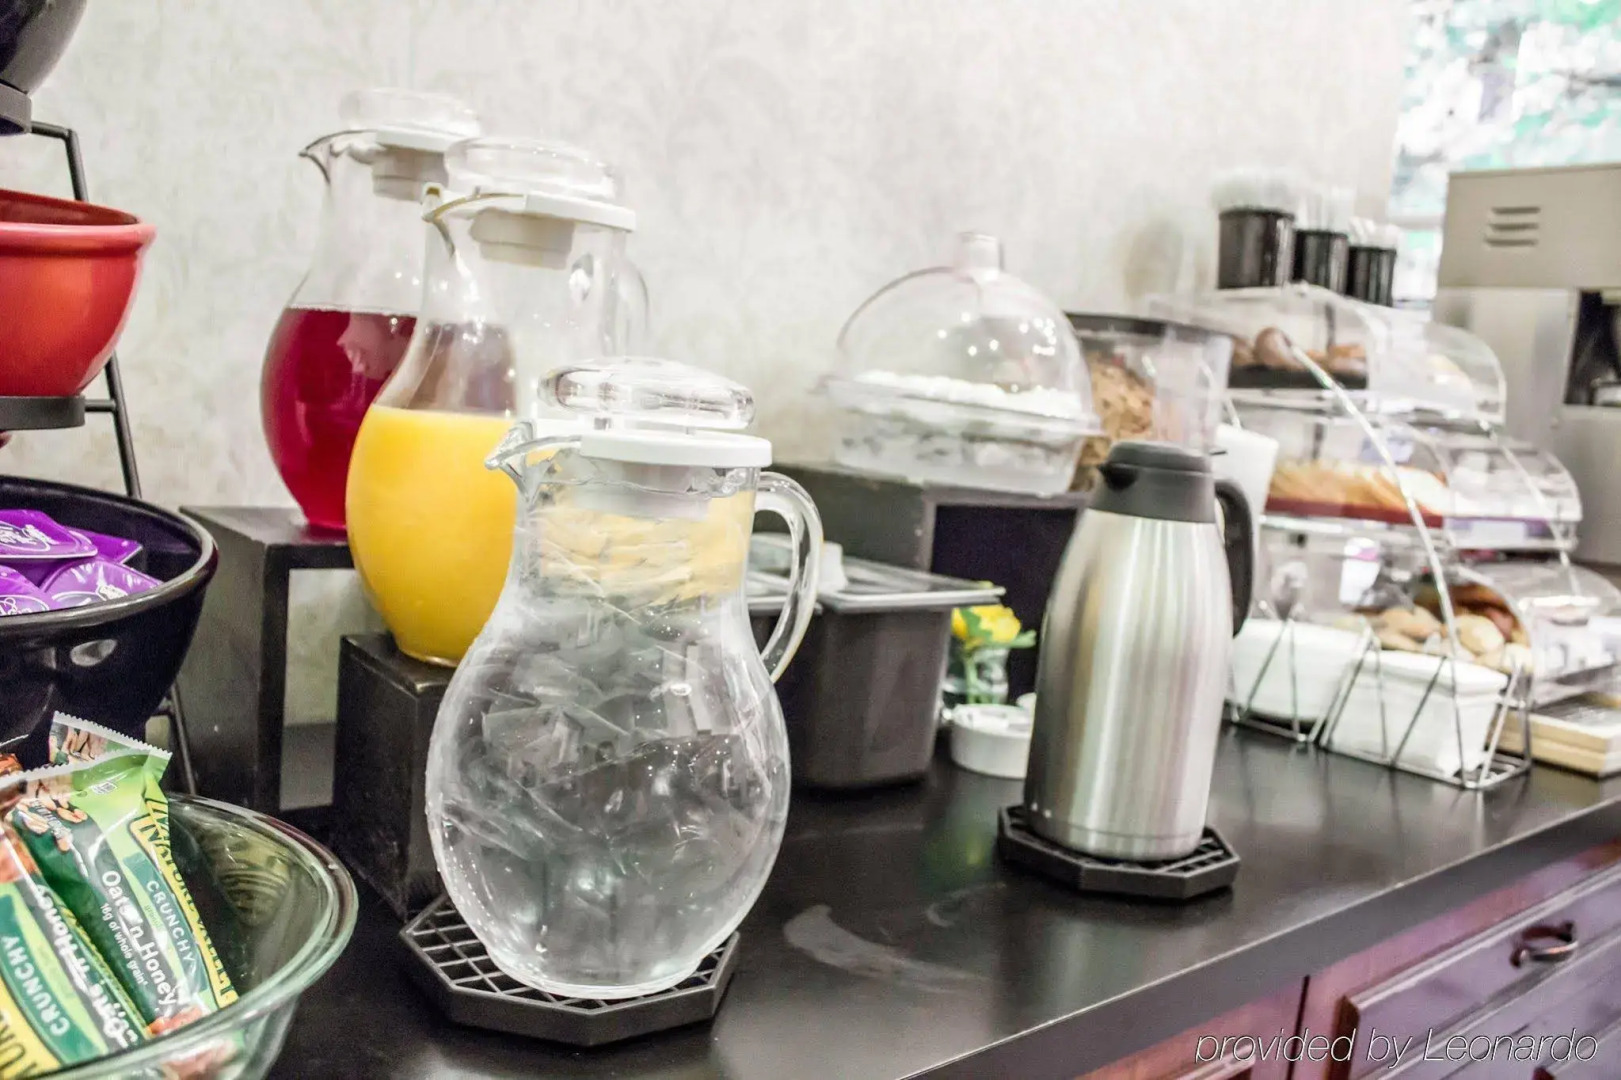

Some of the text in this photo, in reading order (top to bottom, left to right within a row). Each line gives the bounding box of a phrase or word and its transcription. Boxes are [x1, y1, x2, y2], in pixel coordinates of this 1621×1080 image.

[108, 920, 119, 933] of
[113, 930, 132, 959] whole
[146, 879, 196, 963] CRUNCHY
[2, 935, 70, 1037] CRUNCHY
[139, 941, 177, 1006] Honey
